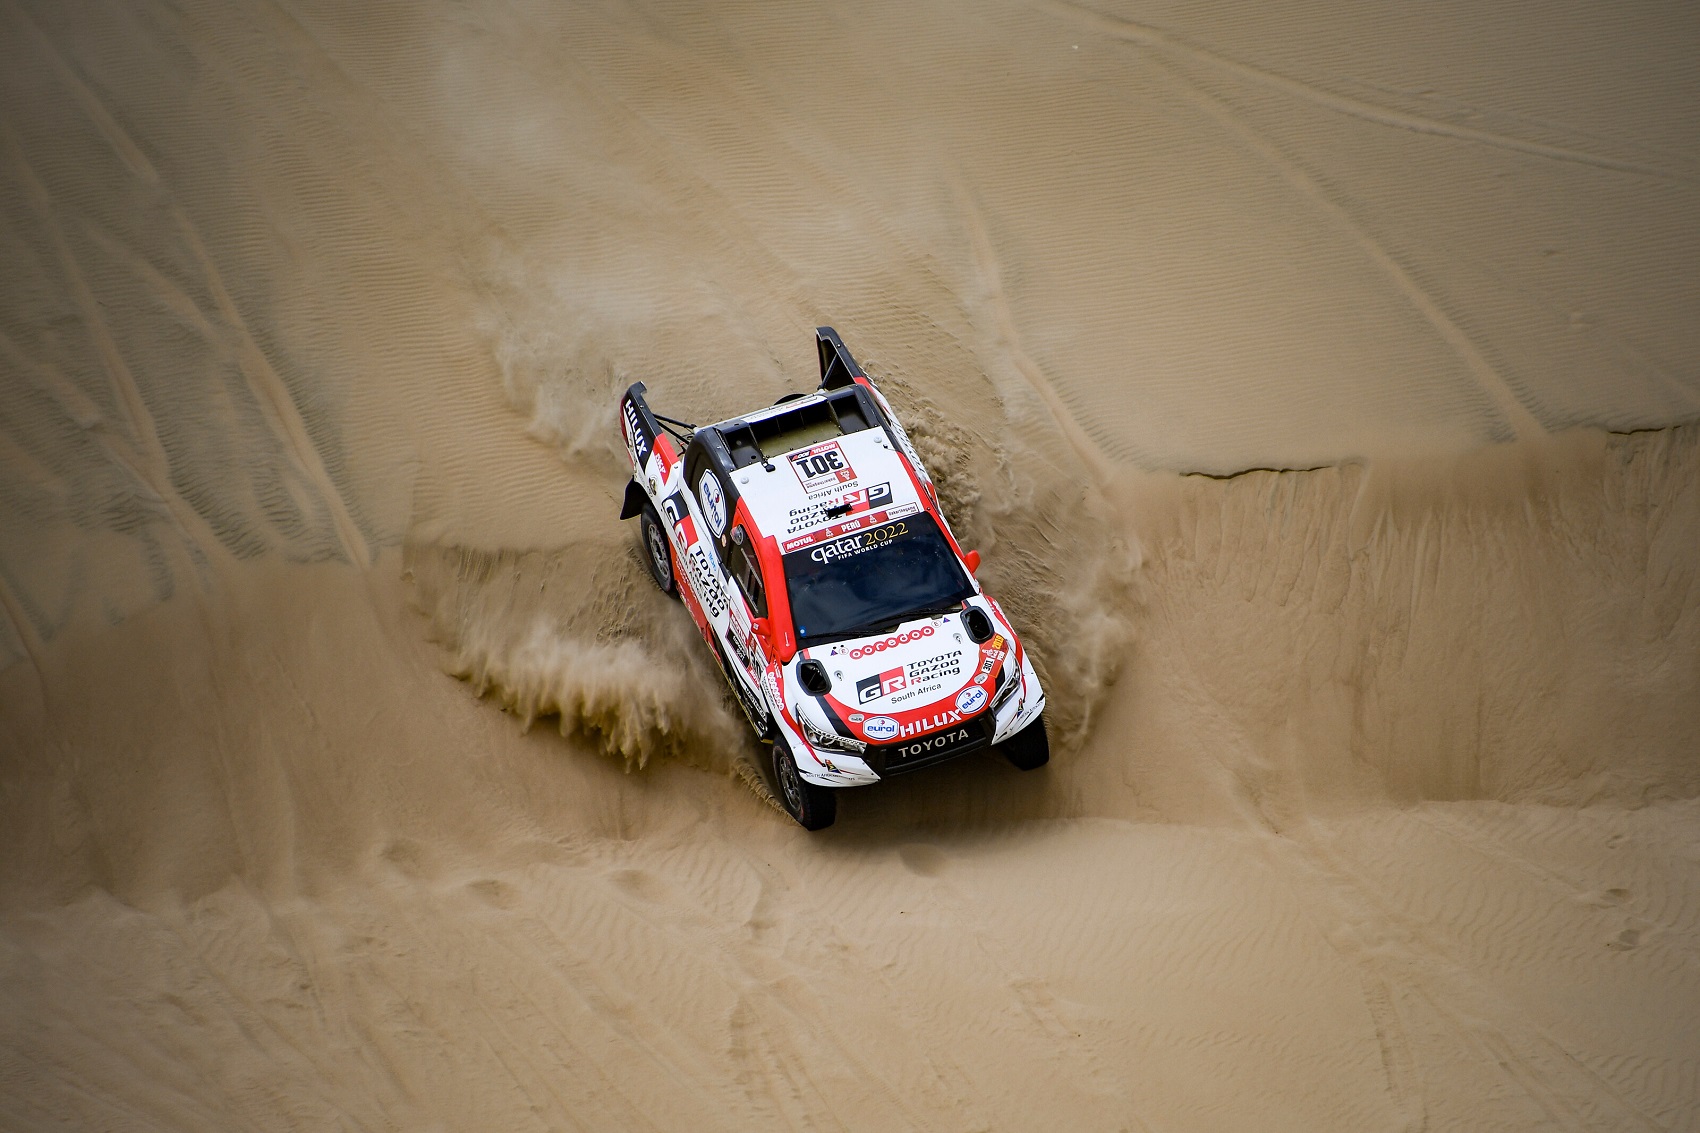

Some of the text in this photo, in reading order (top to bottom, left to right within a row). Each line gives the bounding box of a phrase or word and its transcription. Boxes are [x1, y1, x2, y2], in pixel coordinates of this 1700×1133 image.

[625, 399, 648, 457] HILUX
[812, 443, 836, 454] MOTUL
[796, 451, 843, 478] 301
[808, 481, 859, 501] South Africa
[703, 482, 722, 528] eurol
[841, 520, 861, 532] PERÚ
[787, 536, 813, 550] MOTUL
[811, 522, 909, 564] qatar 2022
[838, 540, 893, 560] FIFA WORLD CUP
[849, 626, 935, 660] ooredoo
[992, 634, 1005, 650] 2019
[907, 650, 962, 670] TOYOTA
[909, 659, 960, 678] GAZOO
[983, 659, 994, 672] 301
[911, 667, 961, 685] Racing
[859, 675, 905, 703] GR
[891, 683, 942, 704] South Africa
[962, 690, 984, 709] eurol
[867, 724, 895, 733] eurol
[900, 709, 962, 738] HILUX
[898, 729, 969, 758] TOYOTA
